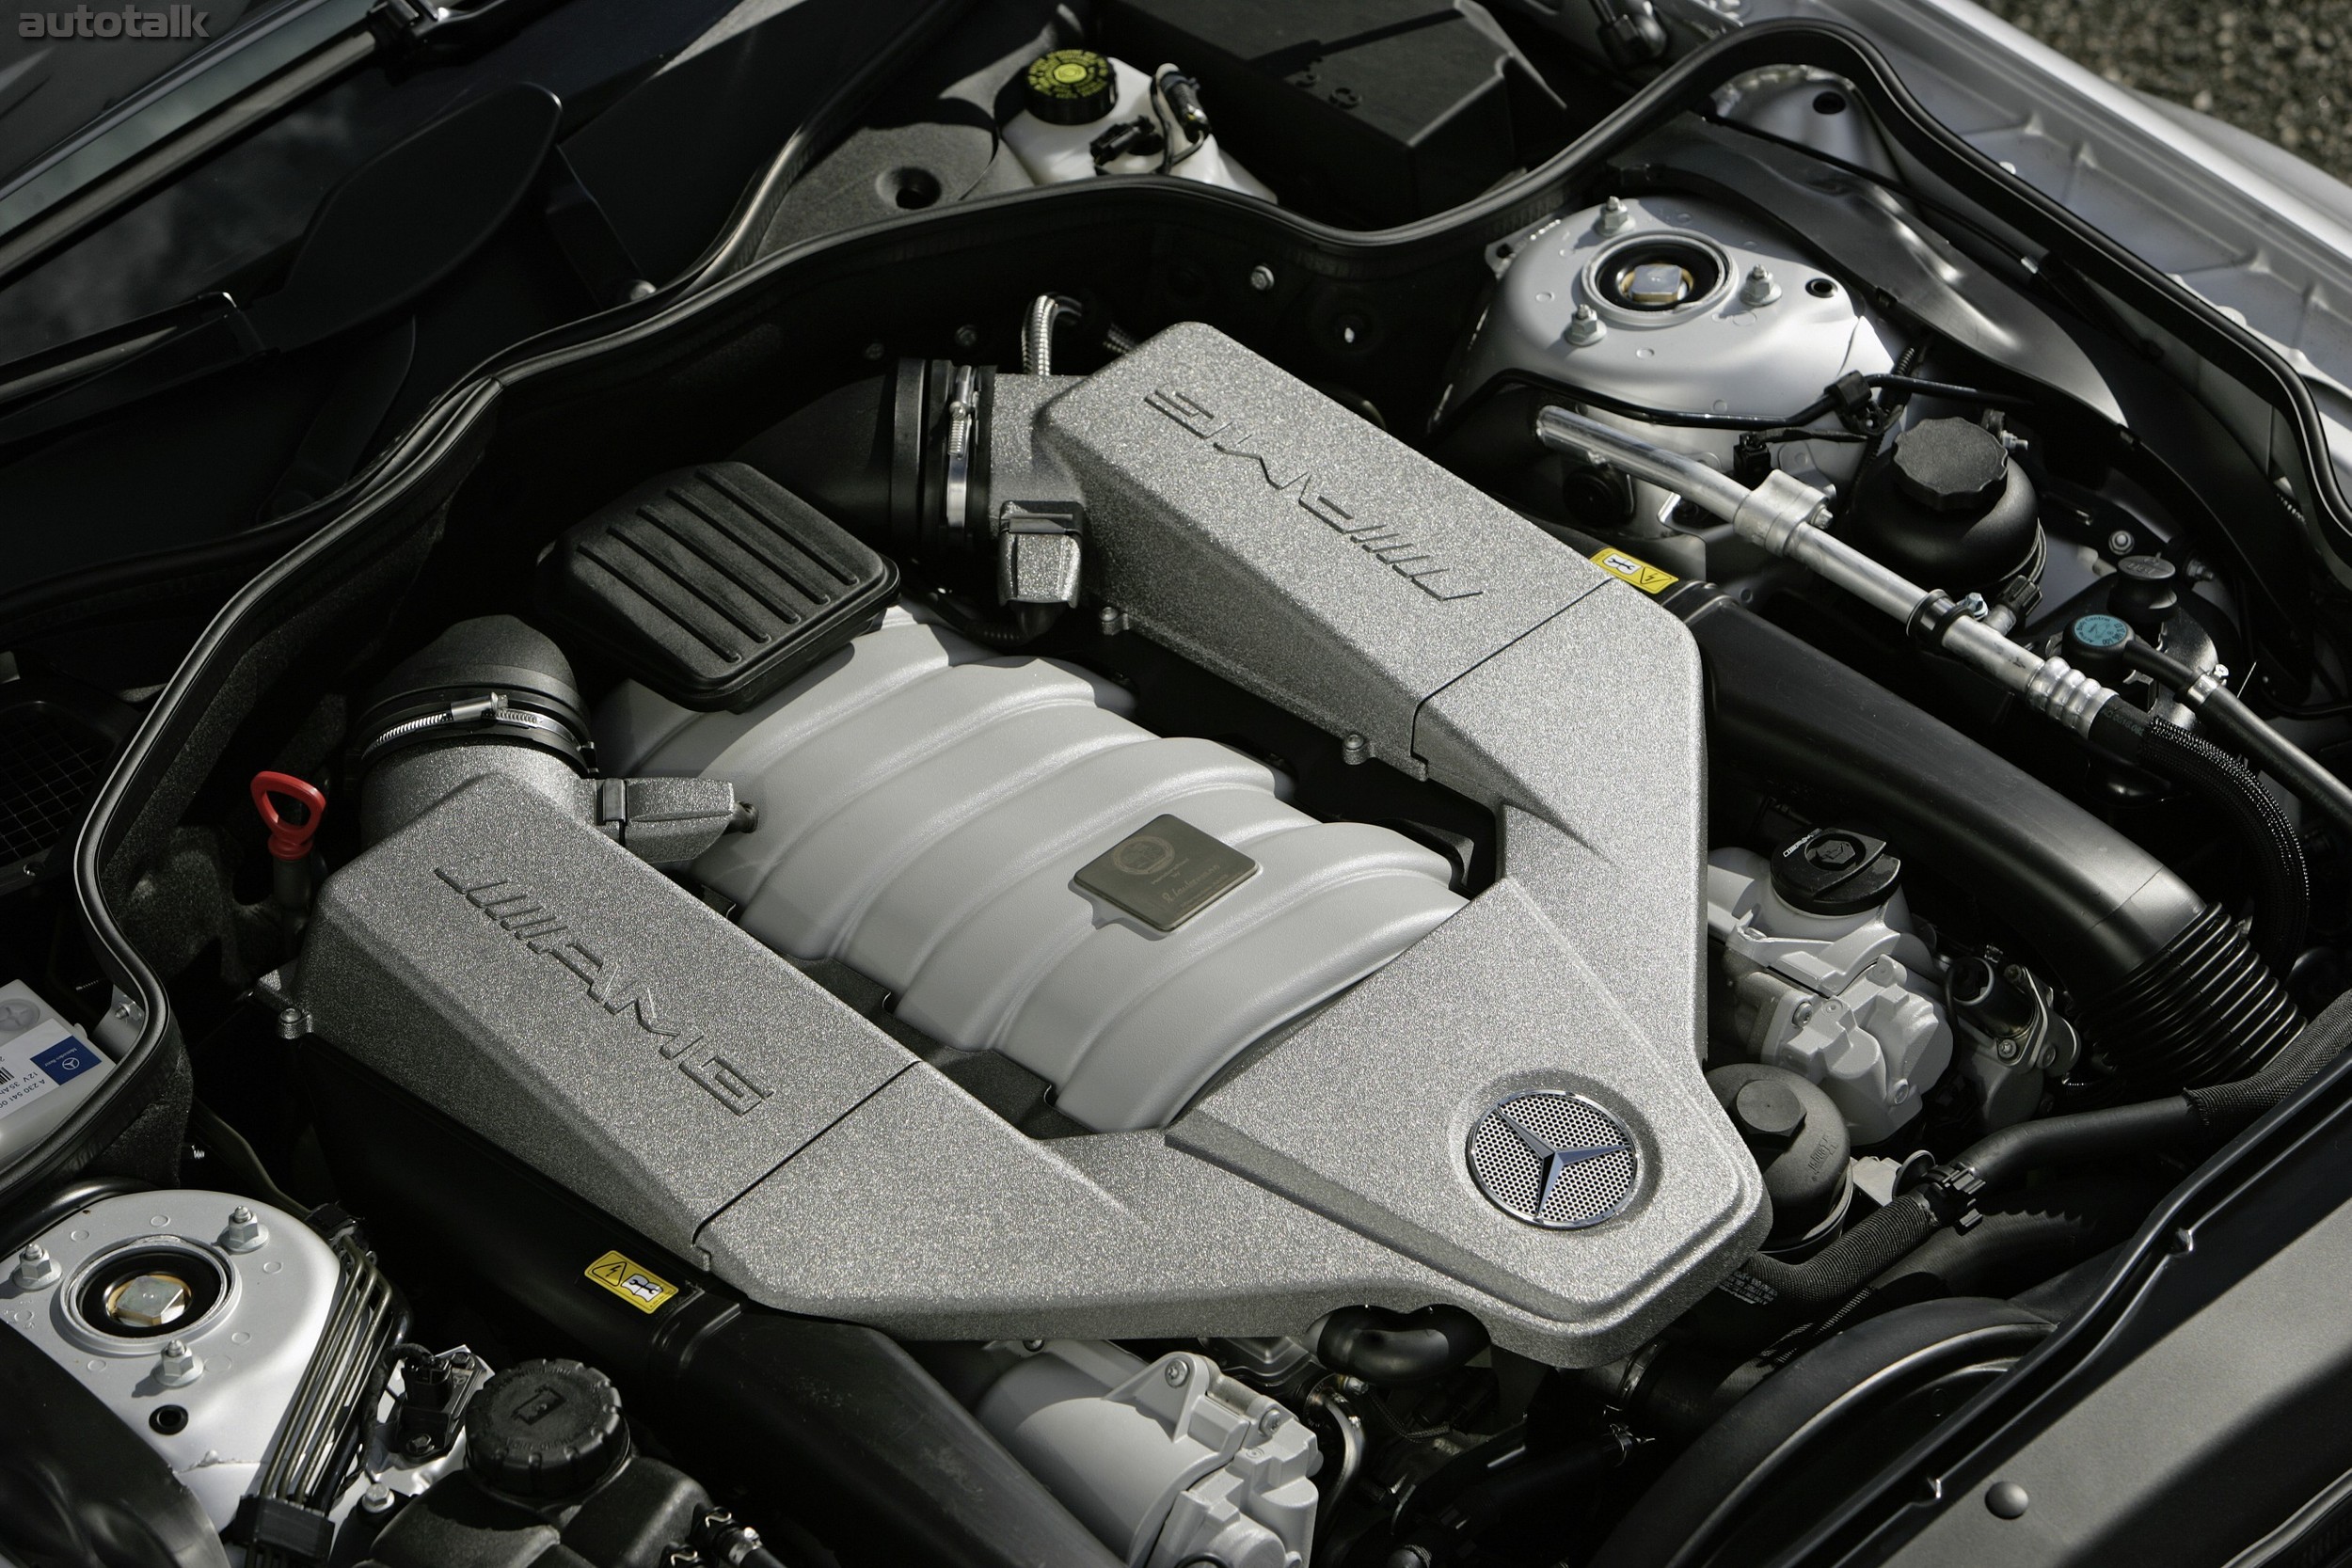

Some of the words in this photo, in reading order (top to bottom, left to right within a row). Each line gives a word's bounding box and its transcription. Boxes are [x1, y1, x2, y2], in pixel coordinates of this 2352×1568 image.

[519, 927, 775, 1117] AMG
[23, 1071, 39, 1083] 12V
[24, 1083, 40, 1094] 230
[8, 1091, 24, 1101] 541
